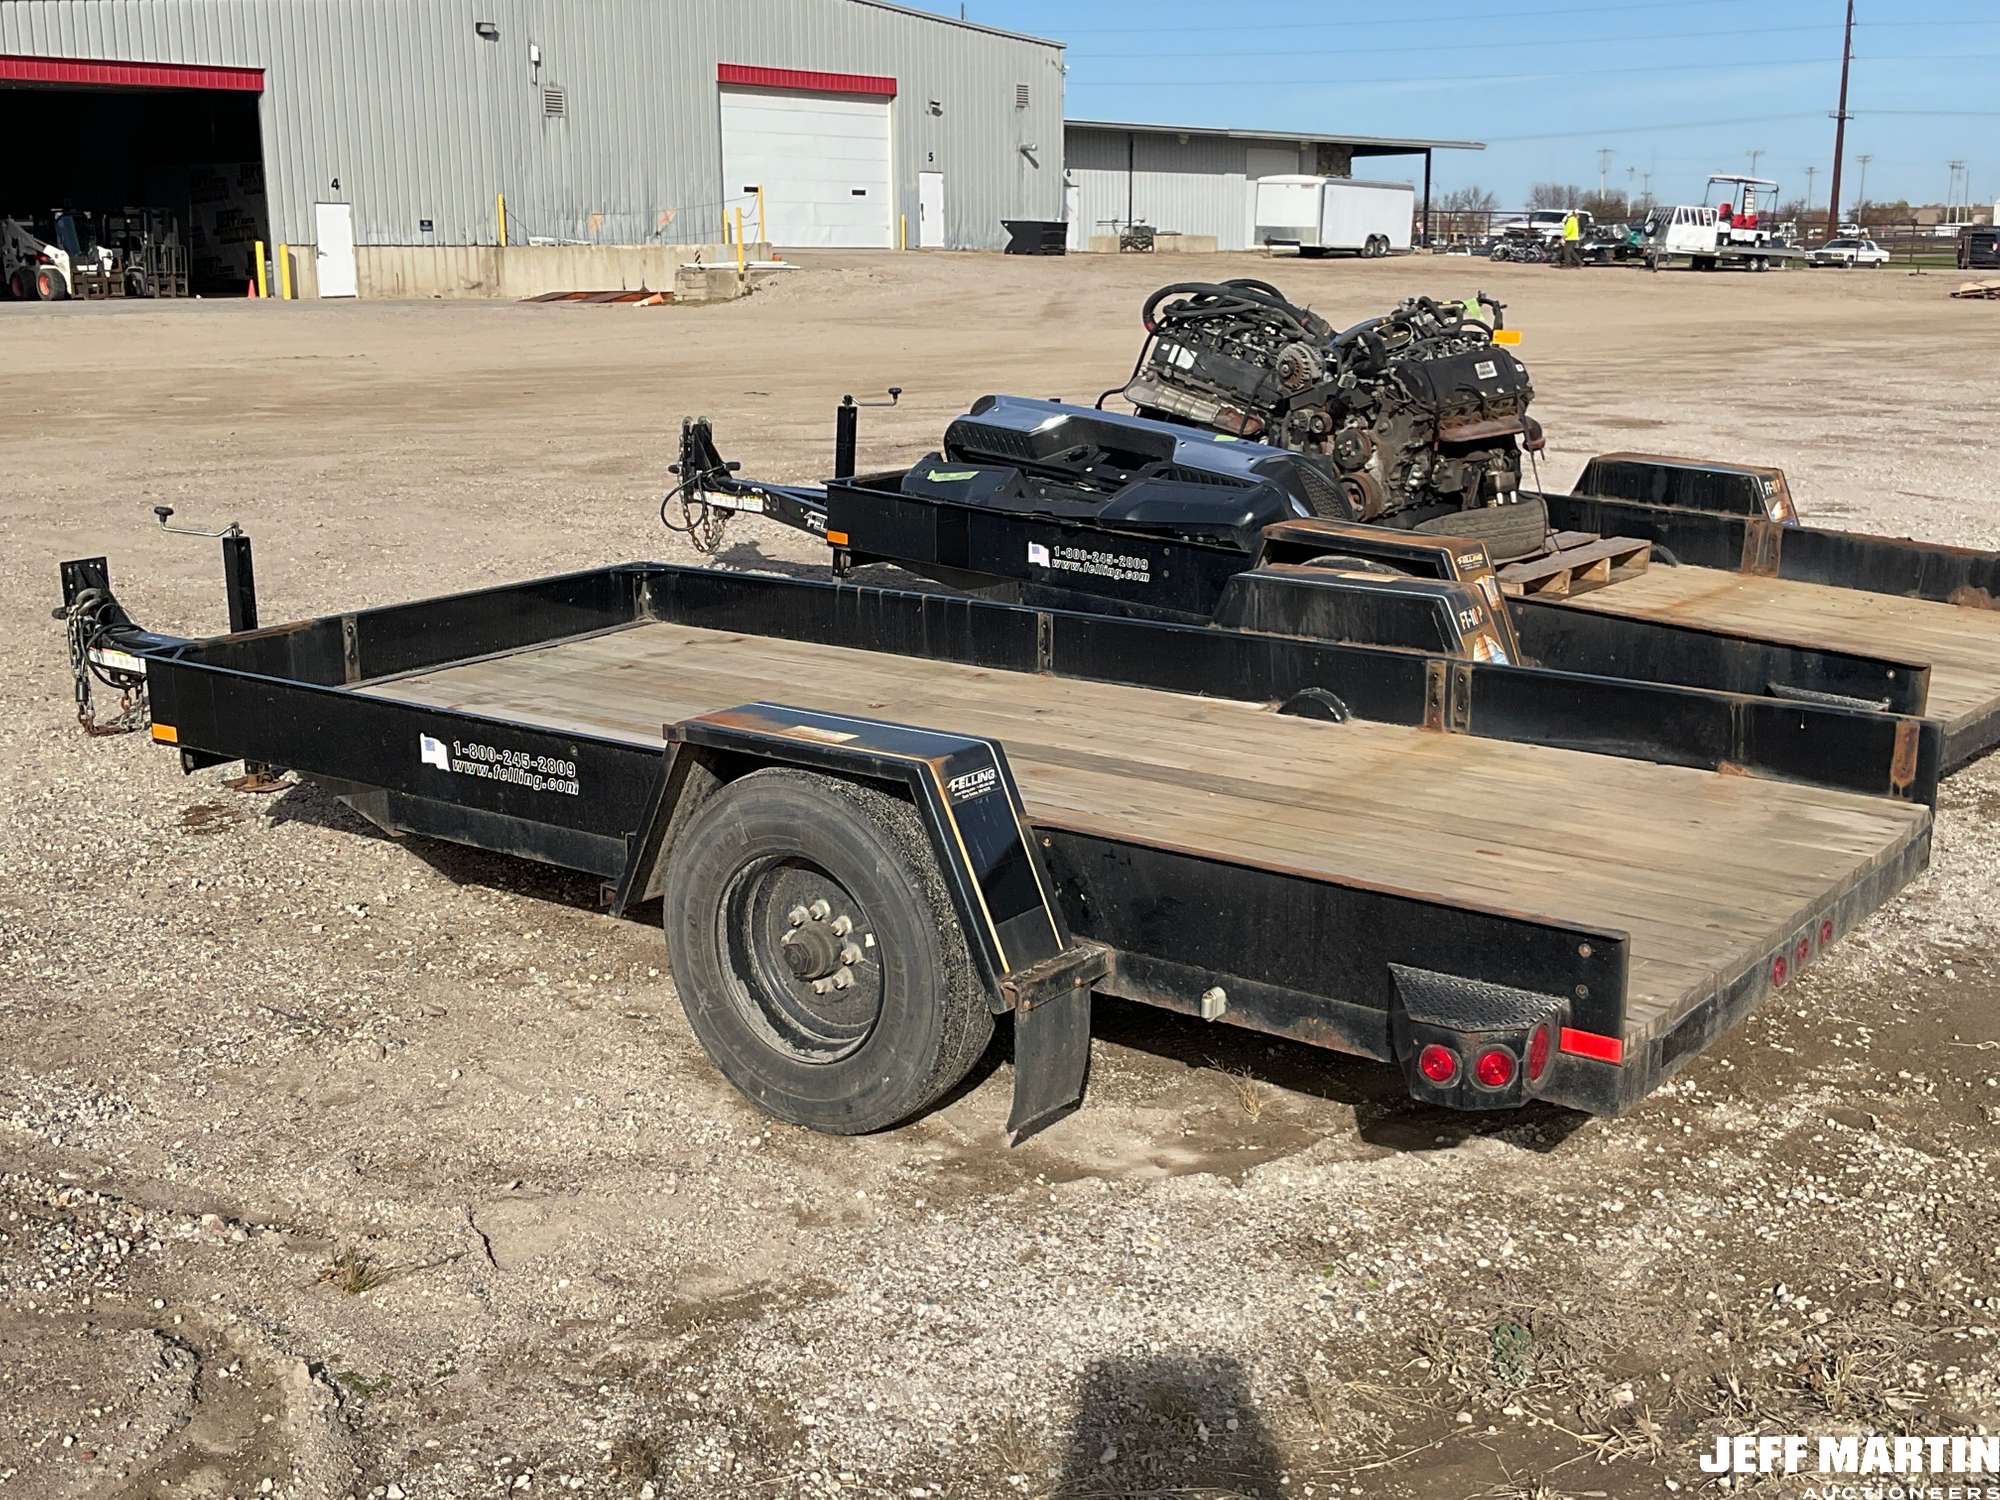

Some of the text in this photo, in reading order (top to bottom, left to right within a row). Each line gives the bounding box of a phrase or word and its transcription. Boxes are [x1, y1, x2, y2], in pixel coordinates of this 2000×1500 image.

[928, 152, 934, 162] 5
[331, 178, 340, 190] 4
[1066, 169, 1072, 177] 6
[1054, 546, 1149, 570] 1-800-245-2809
[1052, 559, 1150, 582] www.felling.com
[453, 740, 576, 778] 1-800-245-2809
[452, 759, 579, 795] www.felling.com
[947, 767, 995, 792] FELLING
